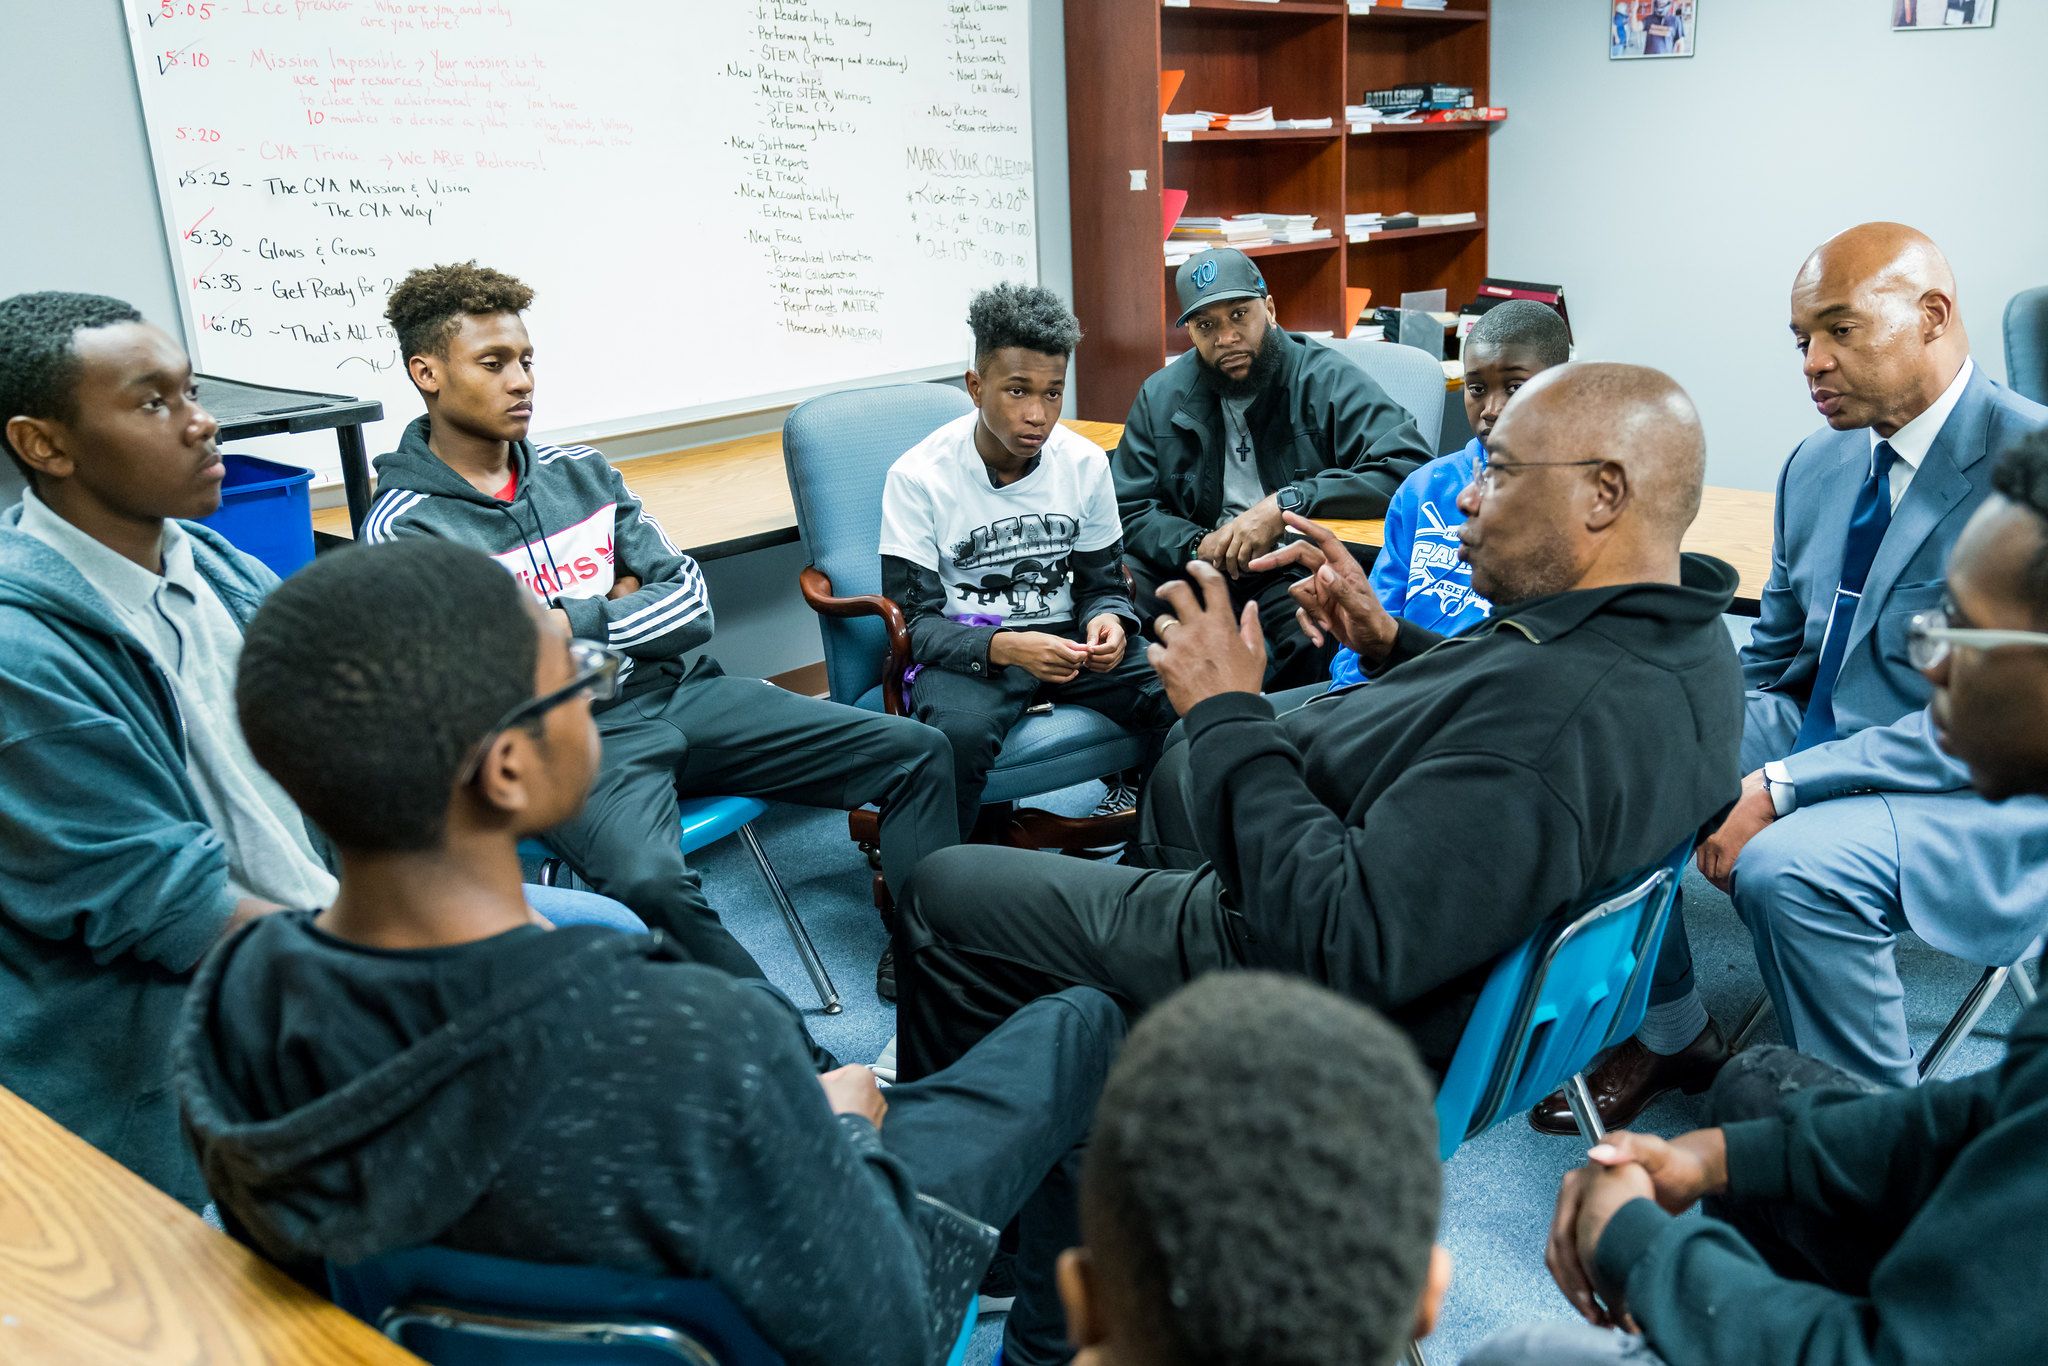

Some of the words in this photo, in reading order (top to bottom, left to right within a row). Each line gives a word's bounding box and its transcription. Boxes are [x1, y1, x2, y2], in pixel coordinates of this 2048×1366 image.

[408, 3, 429, 15] are
[434, 3, 455, 20] you
[460, 2, 482, 16] and
[774, 7, 829, 29] Leadership
[834, 12, 872, 36] Academy
[361, 17, 386, 28] are
[391, 18, 414, 34] you
[758, 25, 810, 51] Performing
[813, 32, 834, 46] Arts
[166, 50, 211, 69] 5:10
[250, 48, 320, 71] Mission
[329, 48, 406, 74] Impossible
[430, 49, 458, 69] Your
[464, 55, 509, 69] mission
[516, 56, 527, 69] is
[761, 44, 800, 63] STEM
[803, 48, 844, 71] (primary
[848, 54, 862, 65] and
[866, 55, 908, 73] secondary)
[293, 75, 320, 86] use
[330, 76, 356, 93] your
[727, 61, 752, 78] New
[757, 63, 823, 89] Partnerships
[761, 83, 793, 99] Metro
[797, 87, 829, 103] STEM
[834, 89, 872, 104] Warriors
[1365, 88, 1425, 106] BATTLESHIP
[308, 109, 324, 124] 10
[767, 101, 809, 116] STEM
[932, 104, 951, 117] New
[770, 115, 818, 141] Performing
[817, 118, 837, 132] Arts
[176, 127, 221, 142] 5:20
[260, 140, 298, 161] CYA
[303, 144, 359, 163] Trivia
[397, 152, 426, 167] We
[433, 150, 465, 167] ARE
[731, 135, 754, 150] New
[758, 133, 807, 152] Software
[774, 154, 809, 170] Reports
[906, 146, 947, 171] MARK
[950, 148, 983, 172] YOUR
[185, 170, 231, 186] 5:25
[263, 177, 298, 195] The
[304, 177, 341, 194] CYA
[350, 178, 405, 194] Mission
[426, 177, 471, 195] Vision
[777, 171, 808, 185] Track
[740, 182, 765, 199] New
[769, 186, 840, 209] Accountability
[359, 202, 393, 218] CYA
[763, 204, 803, 221] External
[808, 208, 855, 221] Evaluator
[189, 230, 233, 247] 5:30
[259, 238, 304, 259] Glows
[331, 238, 376, 258] Grows
[749, 228, 771, 244] New
[775, 229, 802, 244] Focus
[829, 250, 874, 263] Instruction
[199, 273, 242, 292] 5:35
[272, 279, 307, 299] Get
[307, 278, 355, 308] Ready
[357, 276, 375, 297] for
[780, 295, 812, 317] Report
[841, 299, 879, 313] MATTER
[211, 316, 252, 337] 6:05
[281, 321, 340, 344] That's
[347, 324, 373, 342] All
[786, 318, 831, 338] Homework
[970, 513, 1075, 556] LEAD
